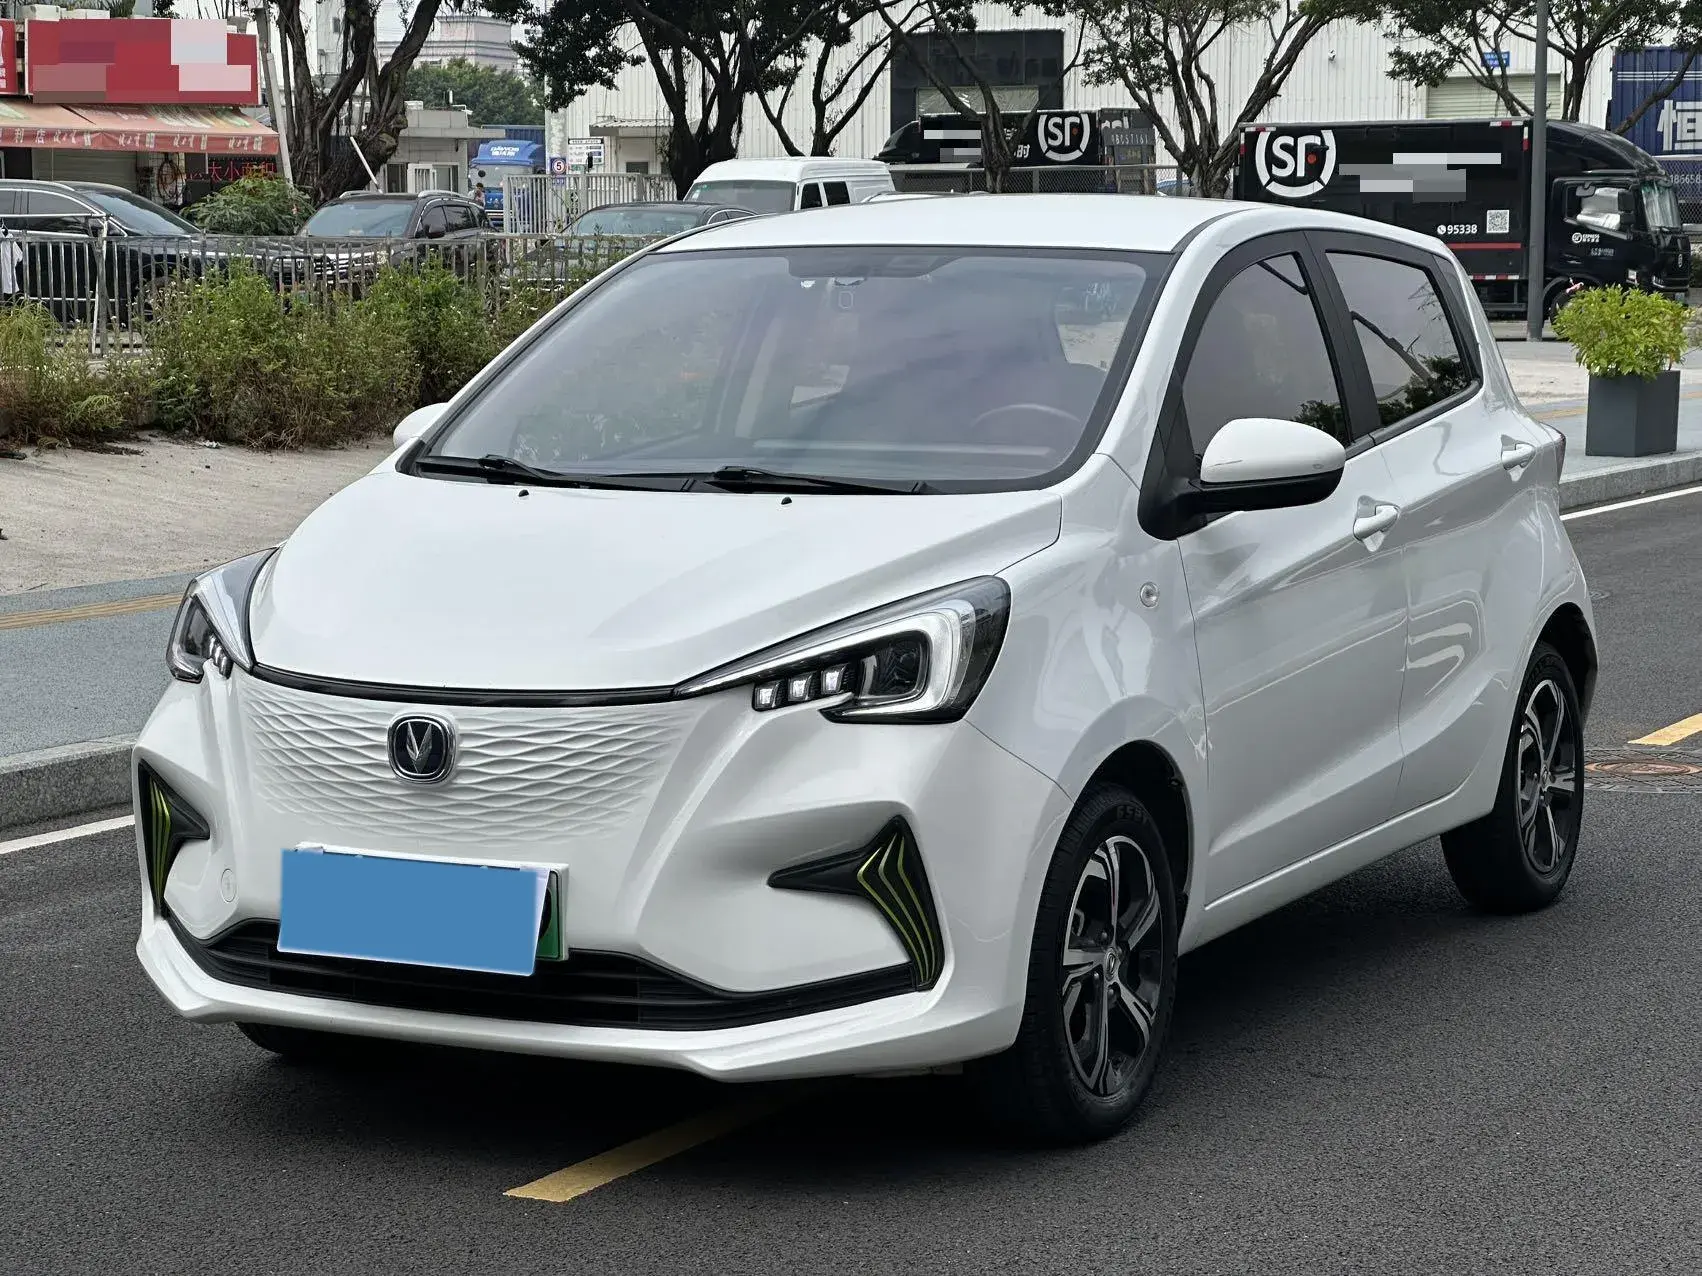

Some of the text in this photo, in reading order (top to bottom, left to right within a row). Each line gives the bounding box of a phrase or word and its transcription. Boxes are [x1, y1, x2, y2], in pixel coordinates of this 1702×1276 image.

[1657, 100, 1702, 151] 恒
[0, 128, 46, 144] 利店
[556, 161, 562, 171] 5
[1446, 224, 1478, 235] 95338
